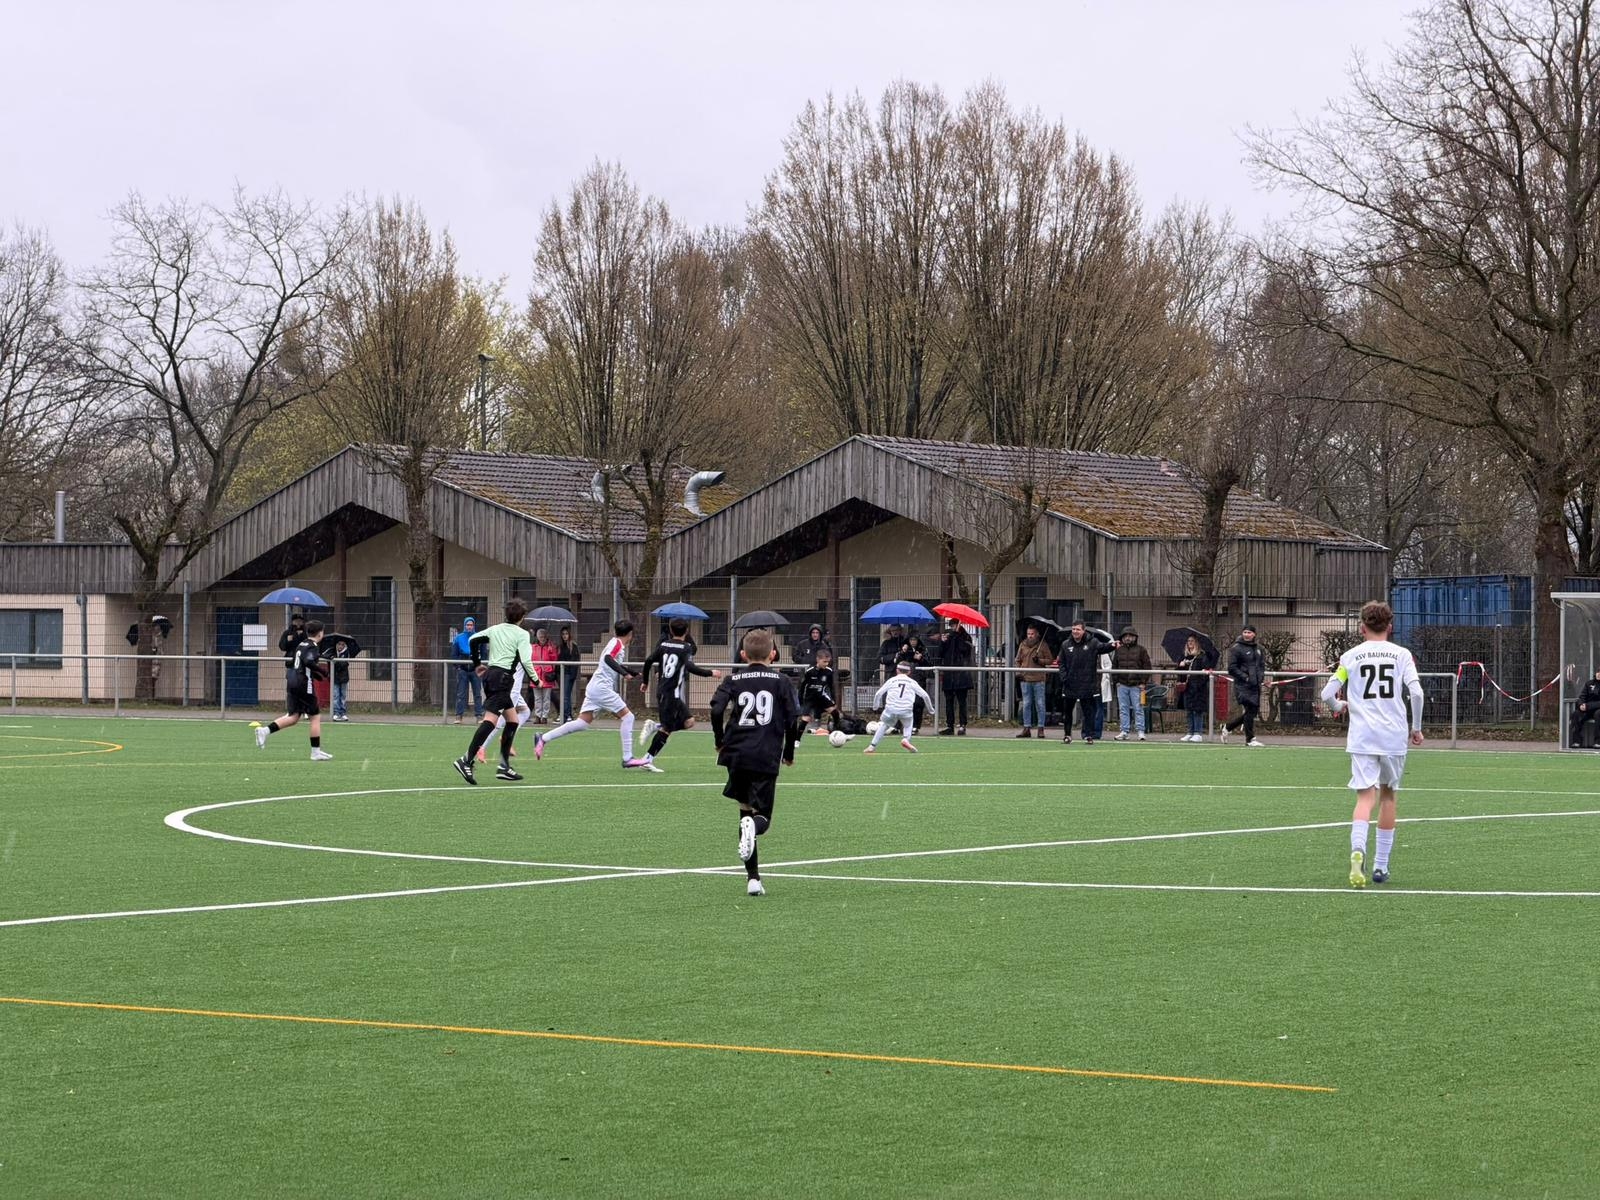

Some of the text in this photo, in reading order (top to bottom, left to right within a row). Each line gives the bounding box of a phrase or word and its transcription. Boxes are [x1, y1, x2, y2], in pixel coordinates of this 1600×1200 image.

[662, 653, 679, 679] 18
[1355, 652, 1398, 661] KSV BAUNATAL
[741, 671, 760, 679] HESSEN
[761, 671, 780, 679] KASSEL
[1360, 664, 1395, 699] 25
[898, 683, 906, 698] 7
[738, 690, 774, 726] 29
